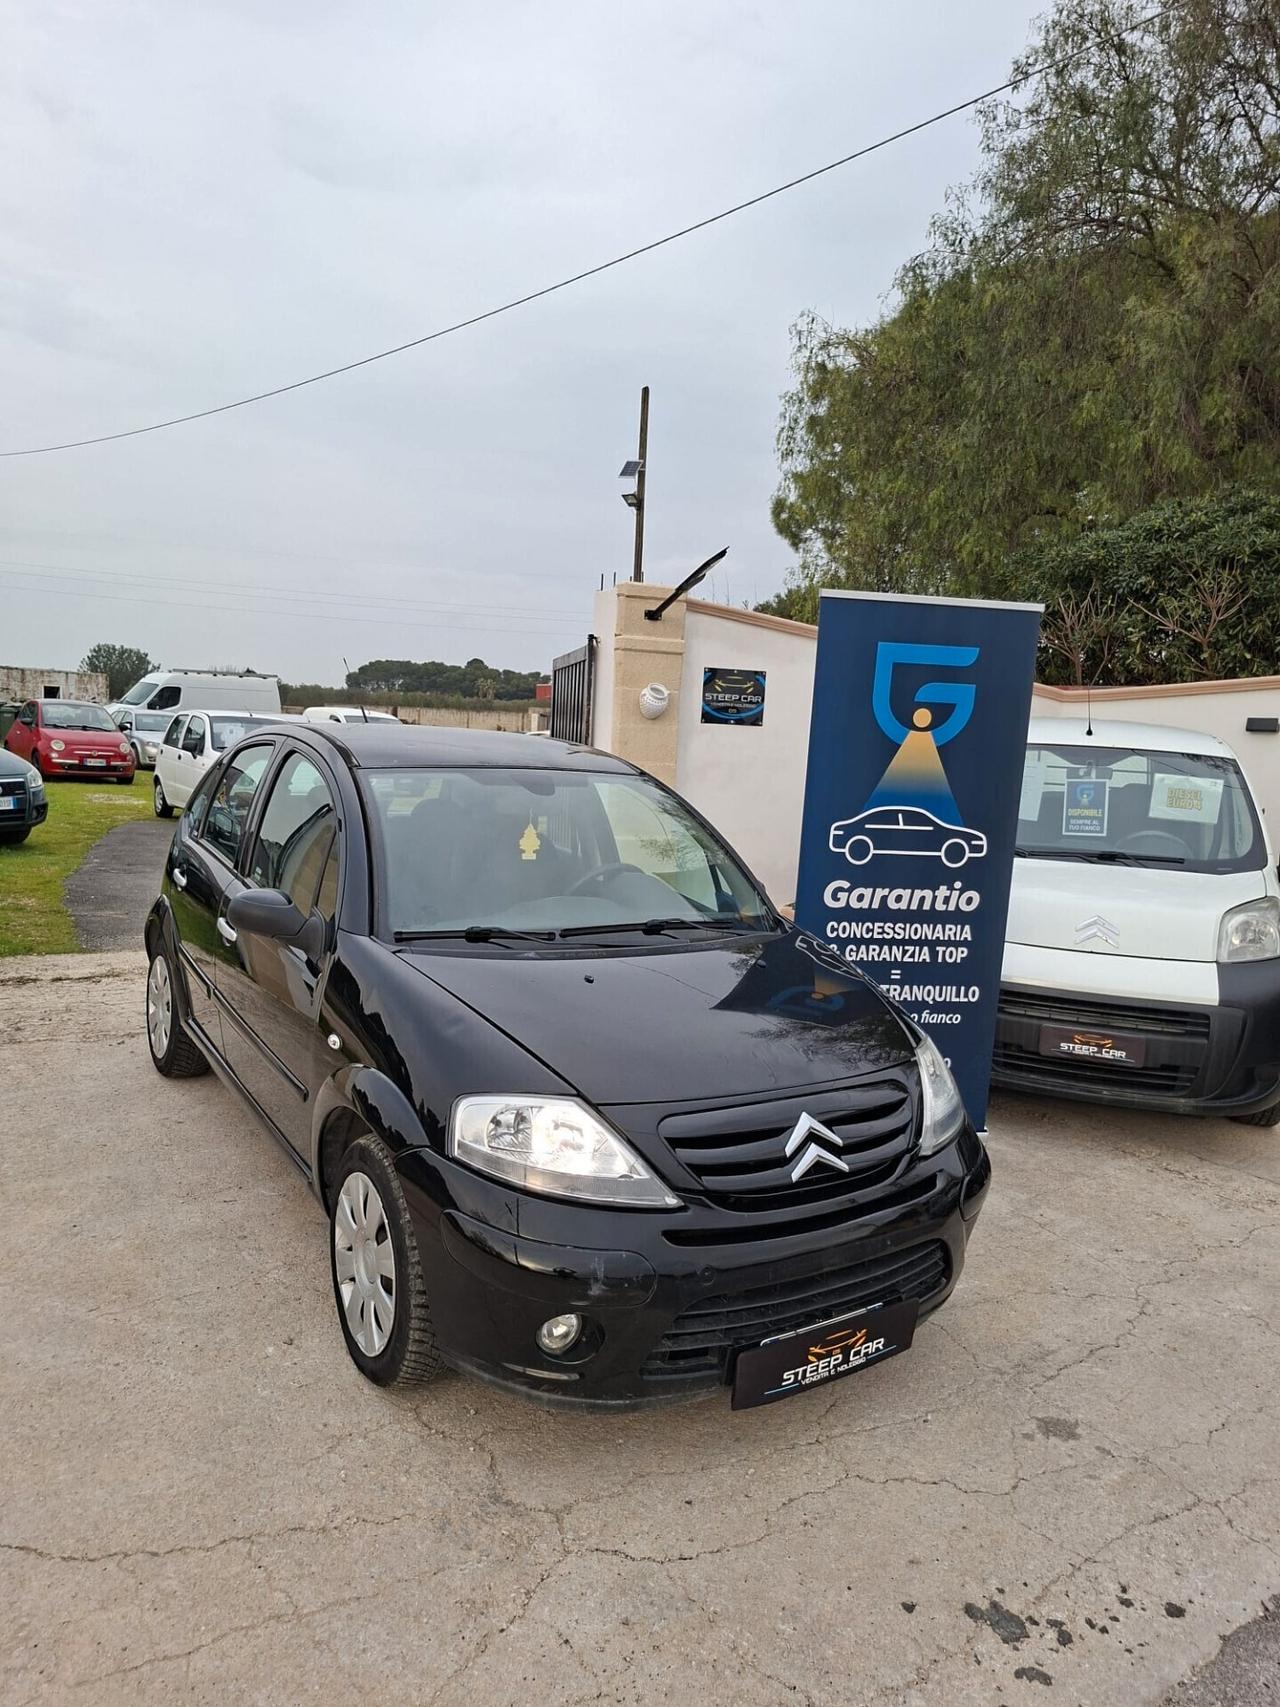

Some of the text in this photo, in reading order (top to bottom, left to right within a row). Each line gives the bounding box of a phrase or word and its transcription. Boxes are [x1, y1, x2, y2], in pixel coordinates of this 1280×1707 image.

[705, 692, 762, 703] STEEP CAR
[1168, 787, 1203, 800] DIESEL
[1067, 808, 1103, 817] DISPONIBILE
[823, 880, 980, 912] Garantio
[826, 921, 972, 941] CONCESSIONARIA
[845, 944, 930, 962] GARANZIA
[936, 946, 968, 963] TOP
[921, 1010, 961, 1024] fianco
[1060, 1042, 1098, 1053] STEEP
[1102, 1048, 1127, 1058] CAR
[781, 1337, 885, 1386] STEEP CAR
[801, 1356, 866, 1385] VENDITA E NOLEGGIO
